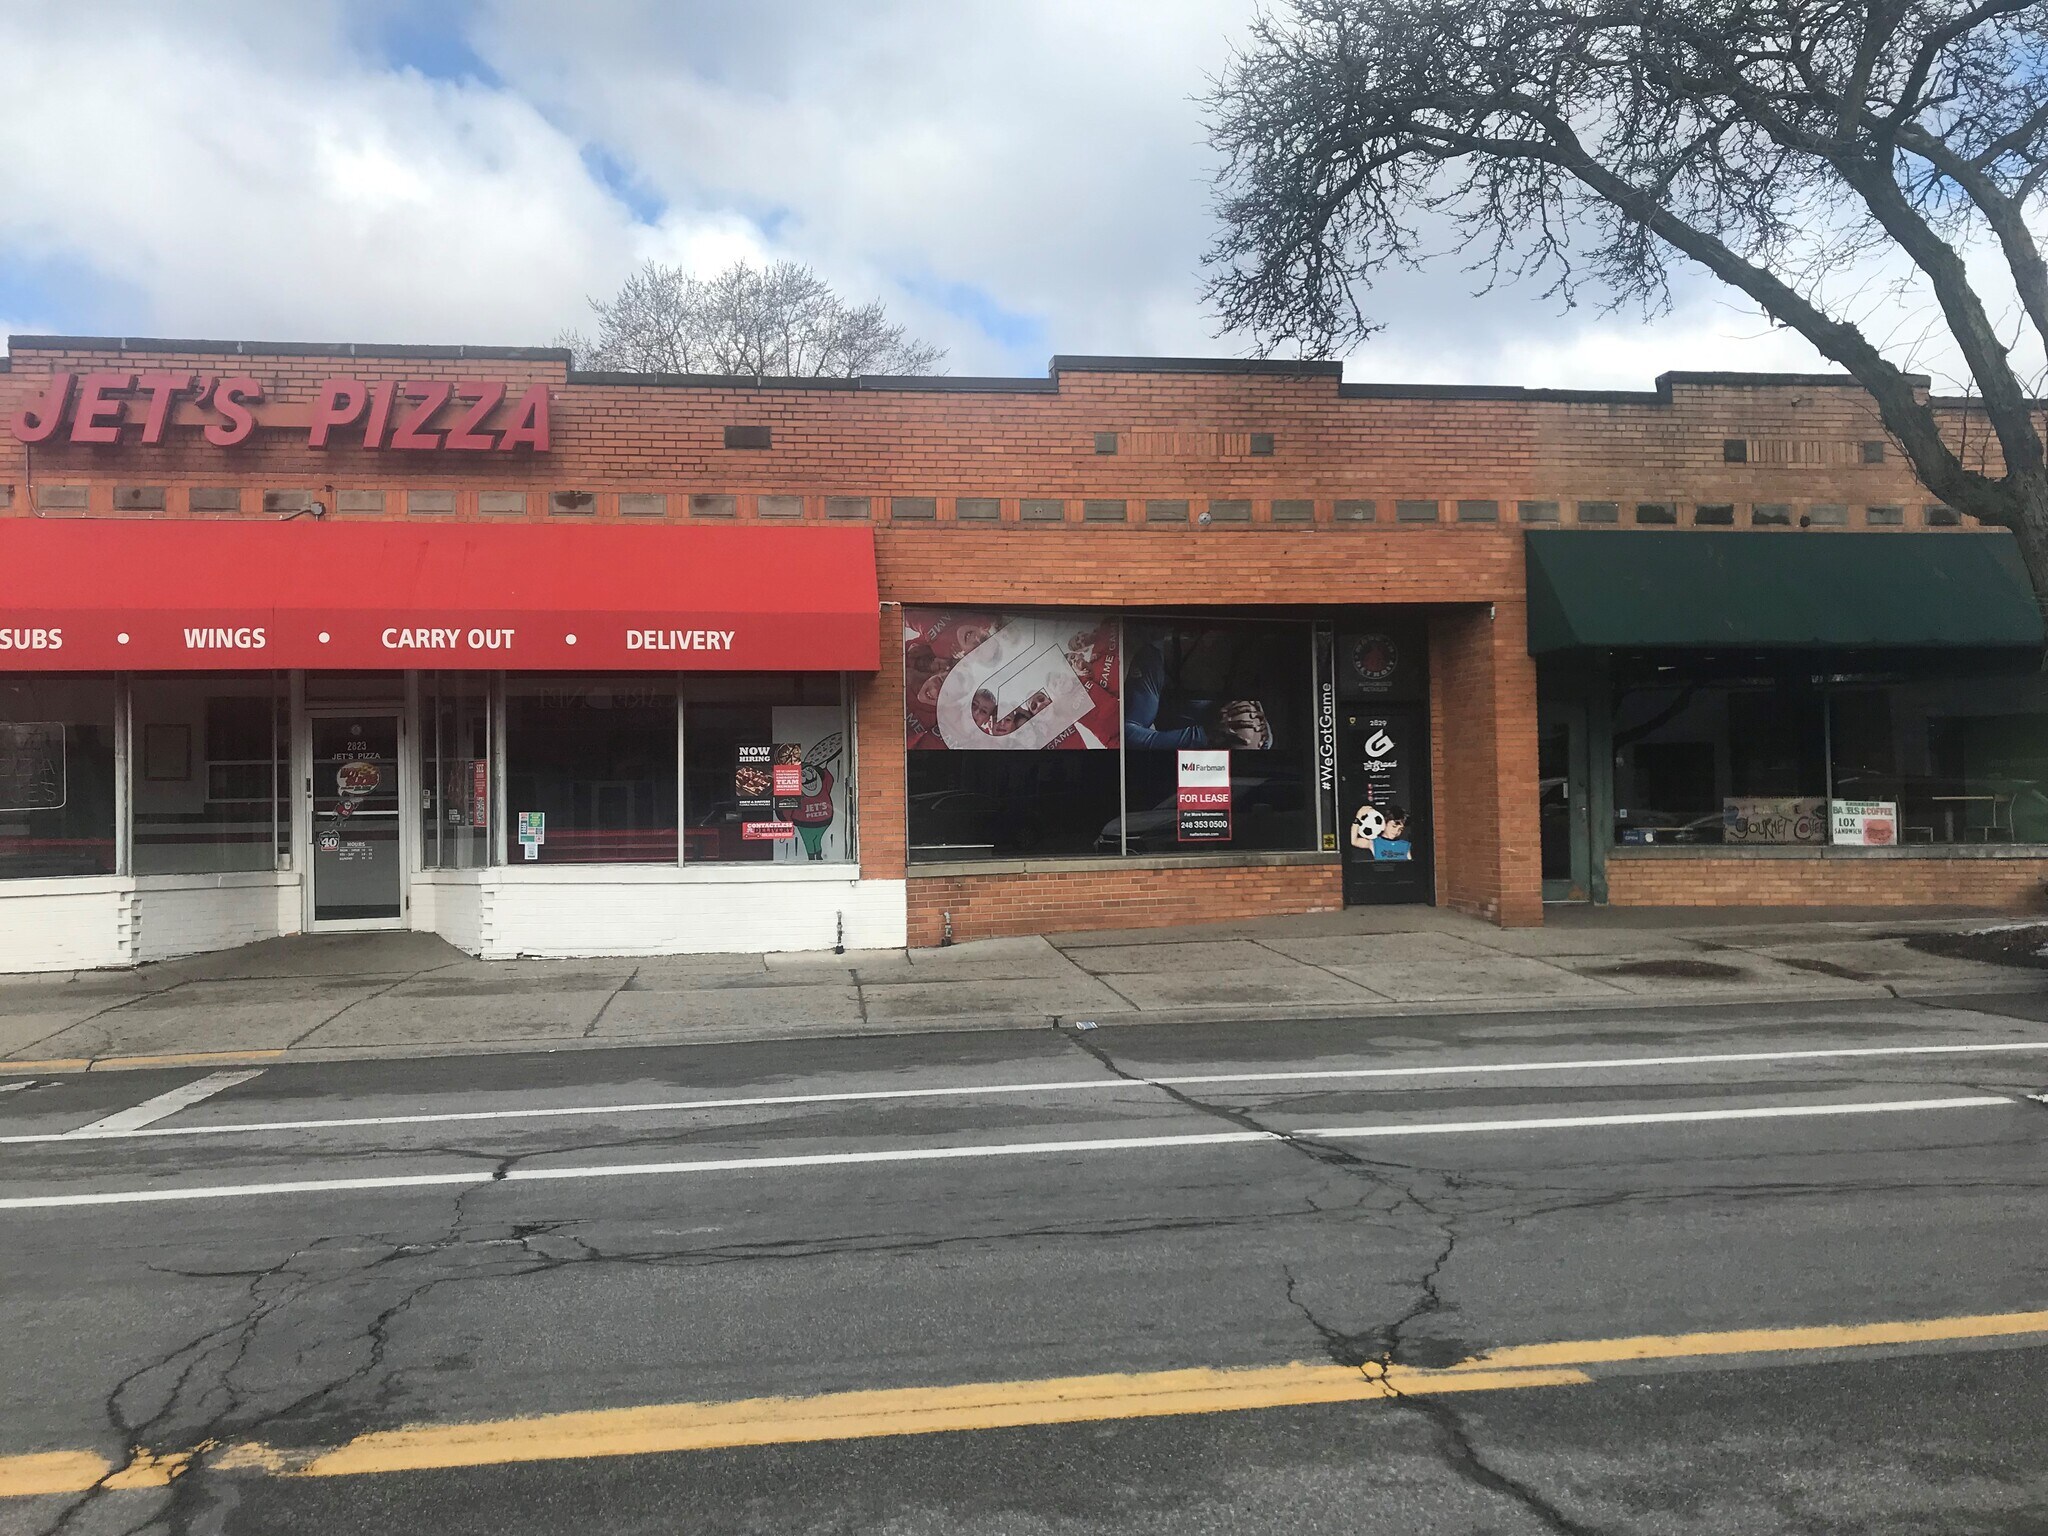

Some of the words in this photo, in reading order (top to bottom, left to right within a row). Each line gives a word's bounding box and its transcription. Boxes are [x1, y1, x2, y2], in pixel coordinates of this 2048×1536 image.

[10, 373, 264, 447] JET'S
[308, 378, 551, 451] PIZZA
[0, 628, 63, 650] SUBS
[184, 627, 266, 649] WINGS
[382, 628, 461, 649] CARRY
[467, 628, 515, 649] OUT
[626, 630, 735, 650] DELIVERY
[1099, 655, 1115, 689] GAME
[1319, 682, 1334, 790] #WeGotGame
[347, 741, 367, 751] 2823
[739, 746, 771, 756] NOW
[357, 752, 381, 760] PIZZA
[1181, 763, 1196, 772] NAI
[1196, 764, 1226, 772] Farbman
[1180, 794, 1198, 803] FOR
[1199, 794, 1229, 803] LEASE
[805, 802, 828, 812] JET'S
[1833, 805, 1860, 815] BAELS
[1866, 807, 1893, 816] COFFEE
[1180, 821, 1194, 829] 248
[1194, 820, 1209, 829] 353
[1208, 820, 1228, 828] 0500
[1838, 818, 1856, 827] LOX
[1834, 827, 1862, 835] SANDWICH
[321, 838, 337, 848] 40
